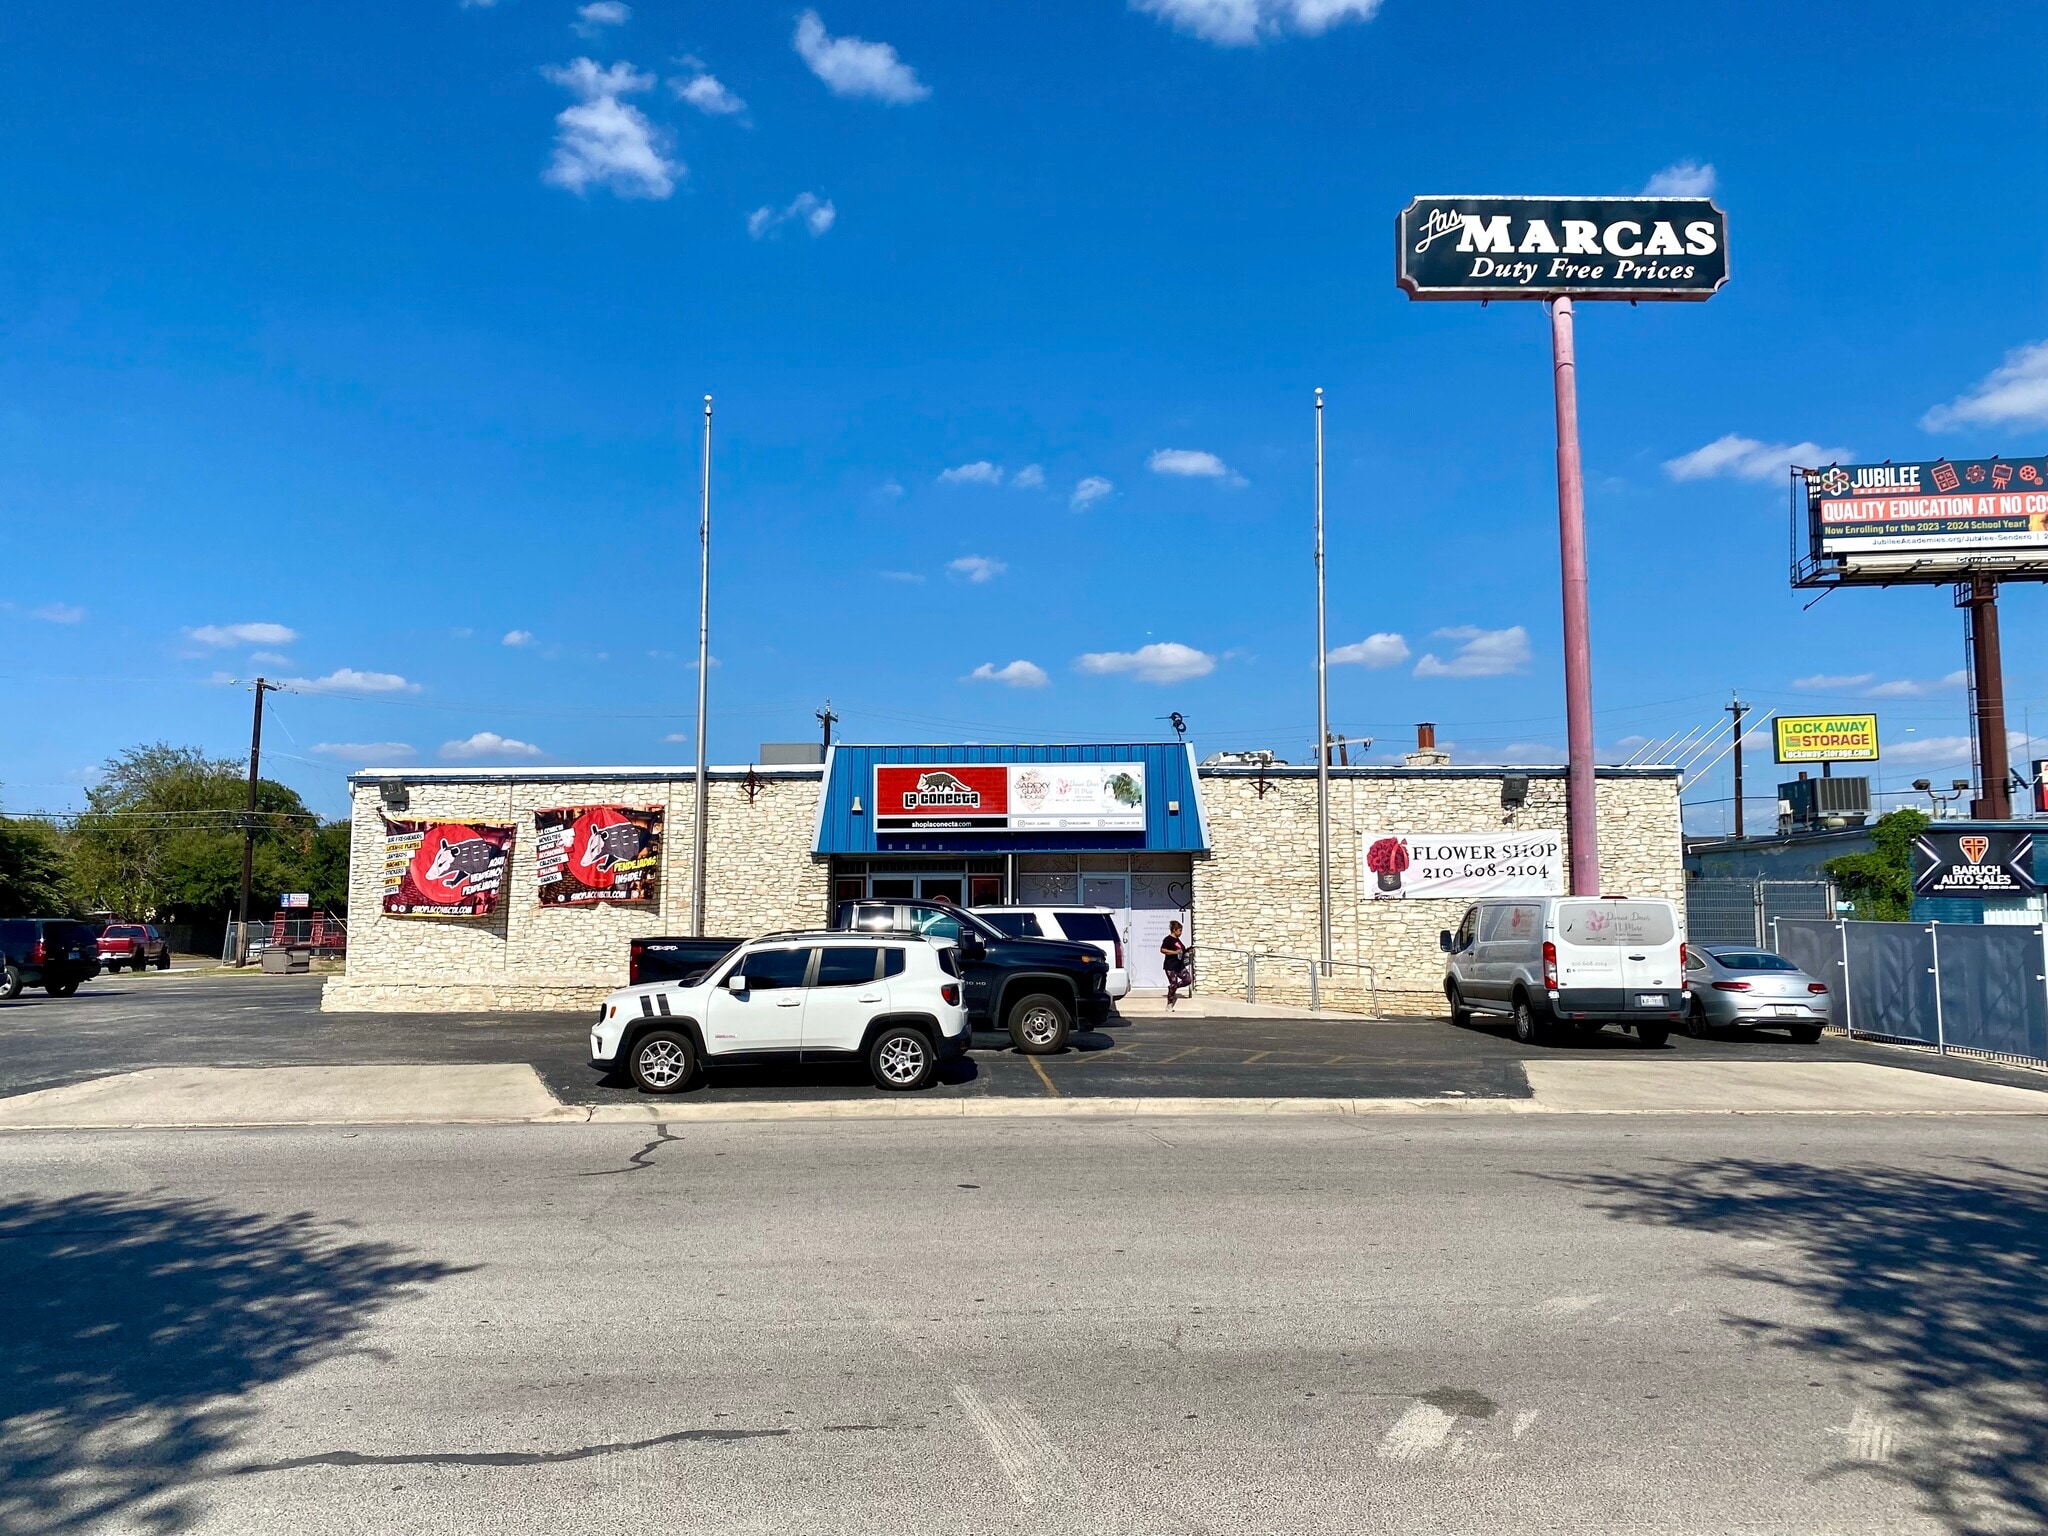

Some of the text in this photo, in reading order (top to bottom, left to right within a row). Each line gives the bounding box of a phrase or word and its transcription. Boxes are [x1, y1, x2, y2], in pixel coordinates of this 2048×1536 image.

[1415, 208, 1717, 256] Las MARCAS
[1469, 257, 1695, 284] Duty Free Prices
[1850, 466, 1920, 488] JUBILEE
[1823, 502, 1885, 521] QUALITY
[1890, 498, 1974, 518] EDUCATION
[1978, 496, 1996, 514] AT
[2000, 496, 2022, 514] NO
[1824, 526, 1844, 534] Now
[1846, 524, 1884, 534] Enrolling
[1886, 523, 1898, 532] for
[1901, 523, 1916, 532] the
[1918, 522, 1940, 532] 2023
[1946, 521, 1970, 530] 2024
[1972, 520, 2000, 529] School
[2002, 520, 2026, 528] Year!
[1785, 721, 1868, 734] LOCK AWAY
[1802, 734, 1869, 746] STORAGE
[1413, 843, 1557, 860] FLOWER SHOP
[614, 856, 657, 872] PENDEJADAS
[1423, 864, 1549, 879] 210-608-2104
[1952, 866, 2000, 875] BARUCH
[615, 870, 642, 884] INSIDE!
[1941, 875, 2011, 885] AUTO SALES
